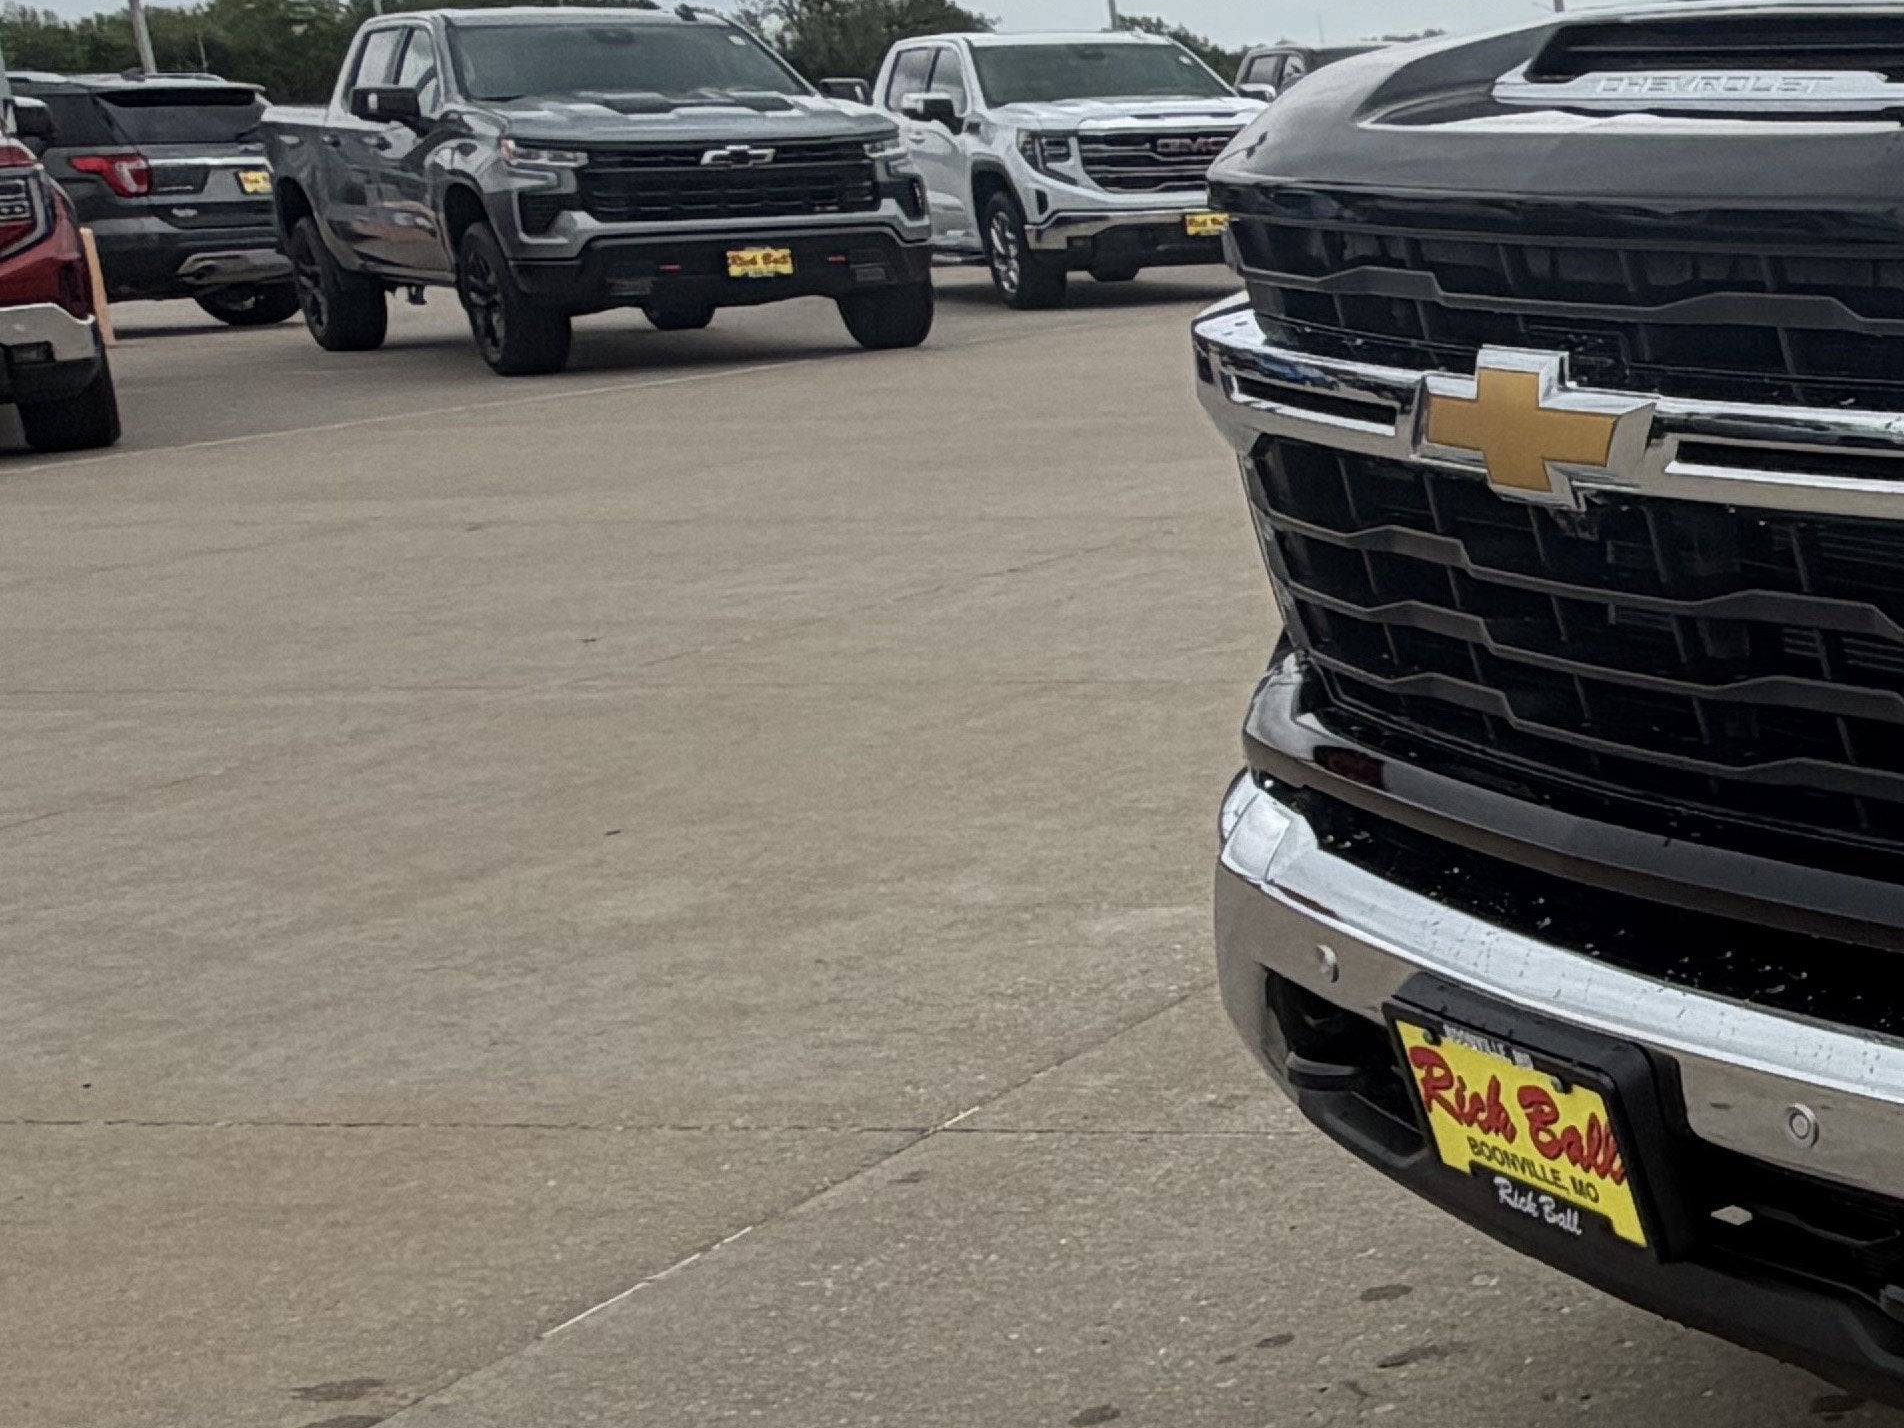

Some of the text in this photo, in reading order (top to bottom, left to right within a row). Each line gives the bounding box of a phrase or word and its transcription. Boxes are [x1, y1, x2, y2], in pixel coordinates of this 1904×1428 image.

[1597, 75, 1835, 94] CHEVROLET
[1408, 1046, 1627, 1186] Rick Ball
[1493, 1175, 1583, 1236] Rick Ball
[1569, 1175, 1600, 1204] MO
